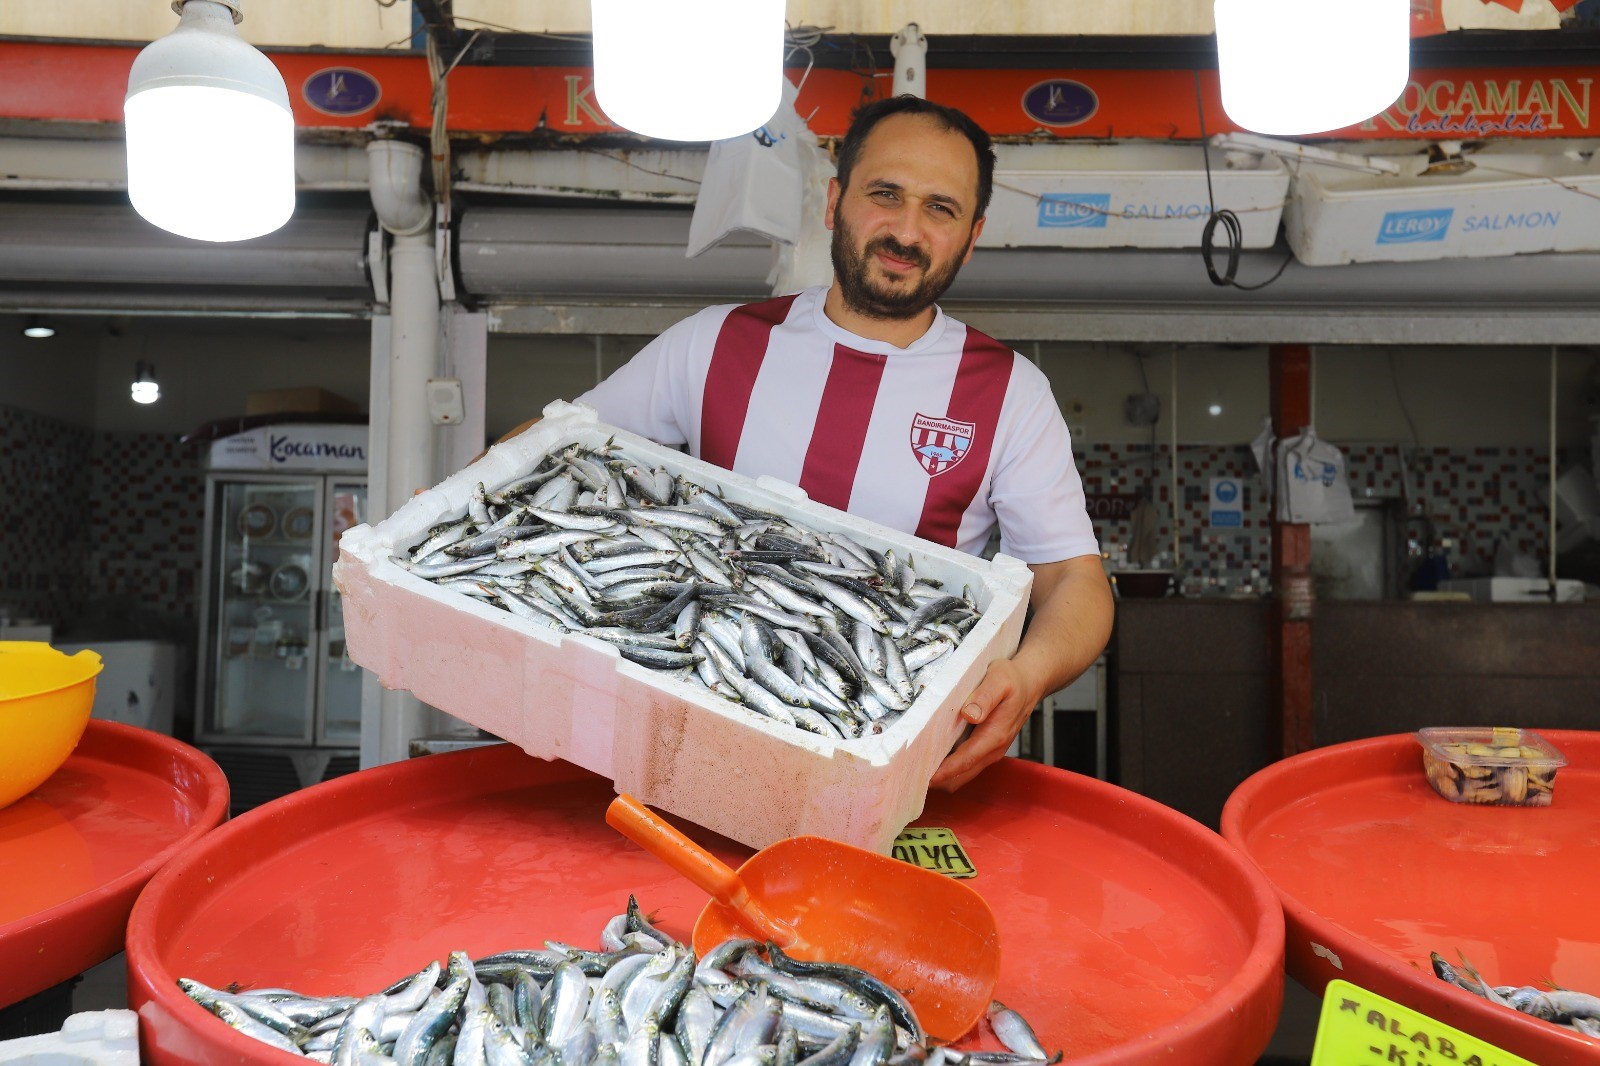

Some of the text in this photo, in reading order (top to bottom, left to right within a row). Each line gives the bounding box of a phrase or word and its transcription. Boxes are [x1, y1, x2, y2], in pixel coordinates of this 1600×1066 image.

[1122, 203, 1220, 220] SALMON
[1461, 211, 1561, 232] SALMON
[917, 418, 970, 435] BANDIRMASPOR
[269, 435, 365, 463] Kocaman
